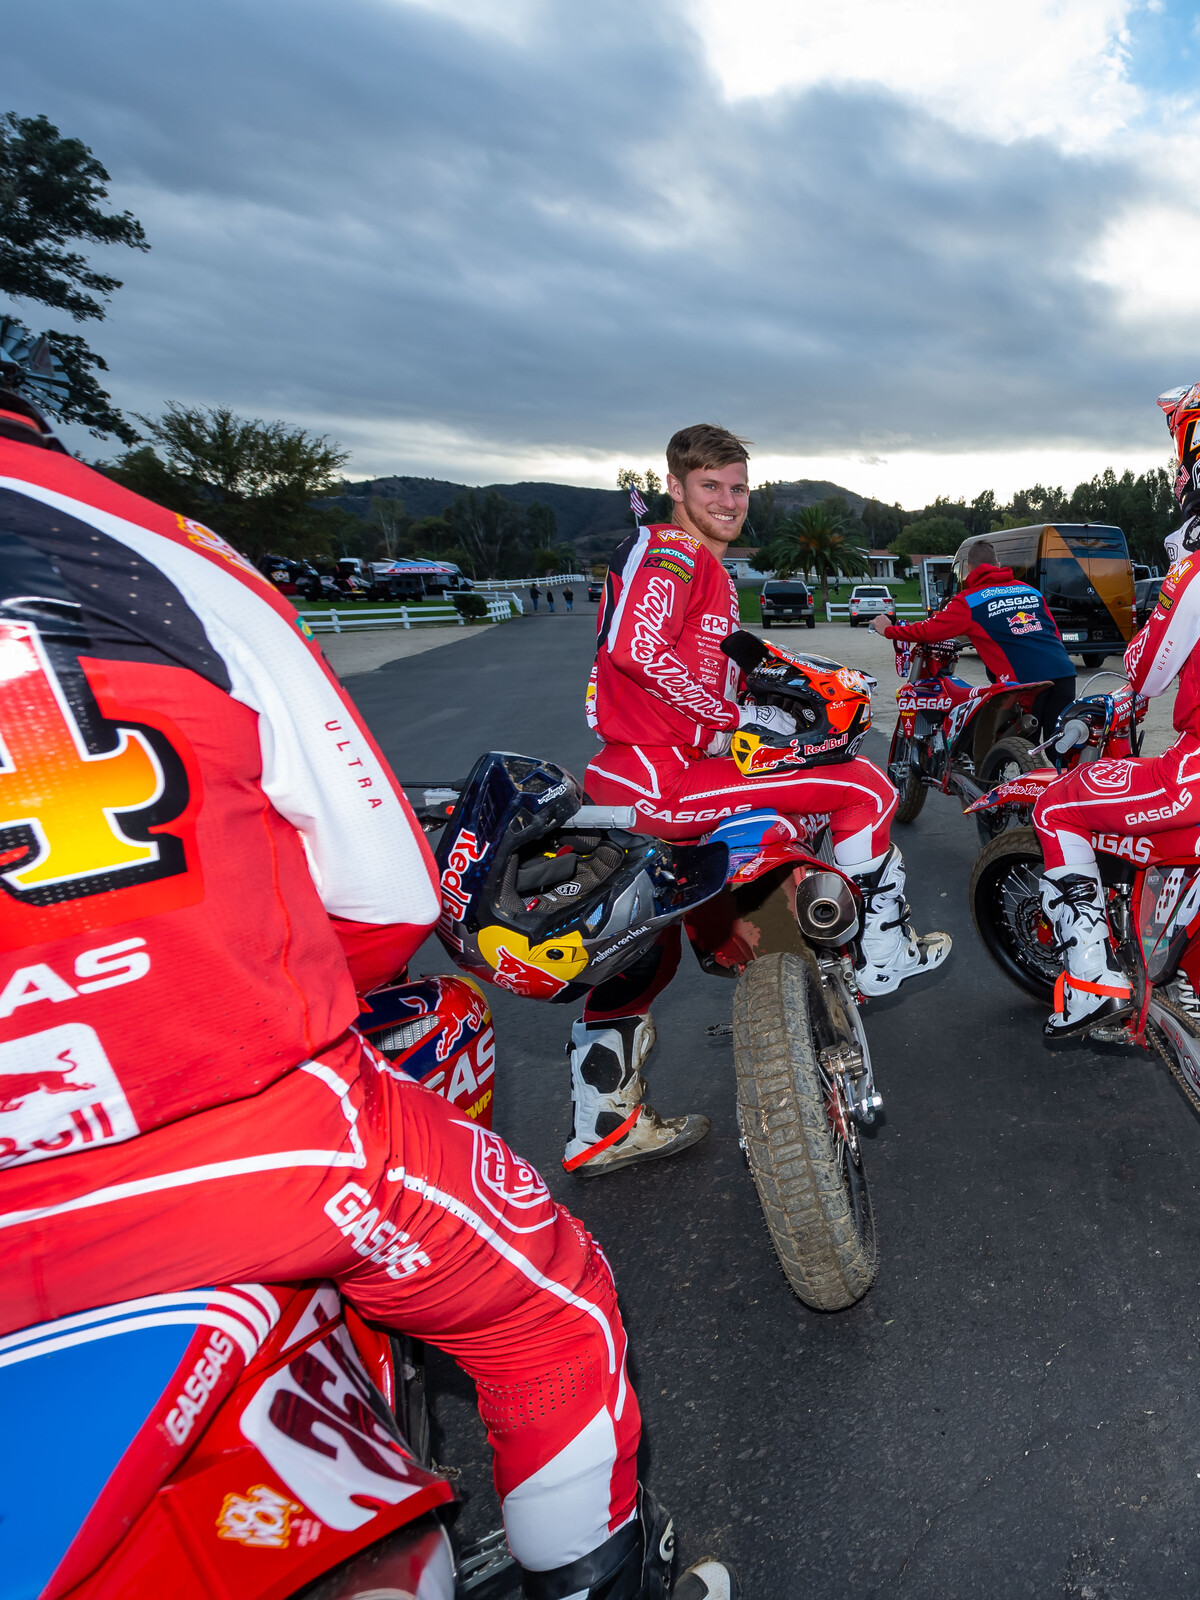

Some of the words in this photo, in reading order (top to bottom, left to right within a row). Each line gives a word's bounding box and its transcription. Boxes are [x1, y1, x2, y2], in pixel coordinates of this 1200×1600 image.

[988, 596, 1038, 611] GASGAS
[988, 606, 1017, 618] FACTORY
[1011, 625, 1028, 634] Red
[1027, 621, 1043, 633] Bull
[1157, 640, 1174, 671] ULTRA
[898, 697, 952, 711] GASGAS
[1115, 694, 1146, 714] RENTAL
[804, 742, 828, 756] Red
[828, 733, 849, 750] Bull
[325, 720, 382, 808] ULTRA
[634, 798, 752, 823] GASGAS
[1125, 788, 1193, 826] GASGAS
[441, 828, 491, 904] Red
[438, 890, 467, 953] Bull
[323, 1182, 431, 1280] GASGAS
[164, 1330, 234, 1446] GASGAS
